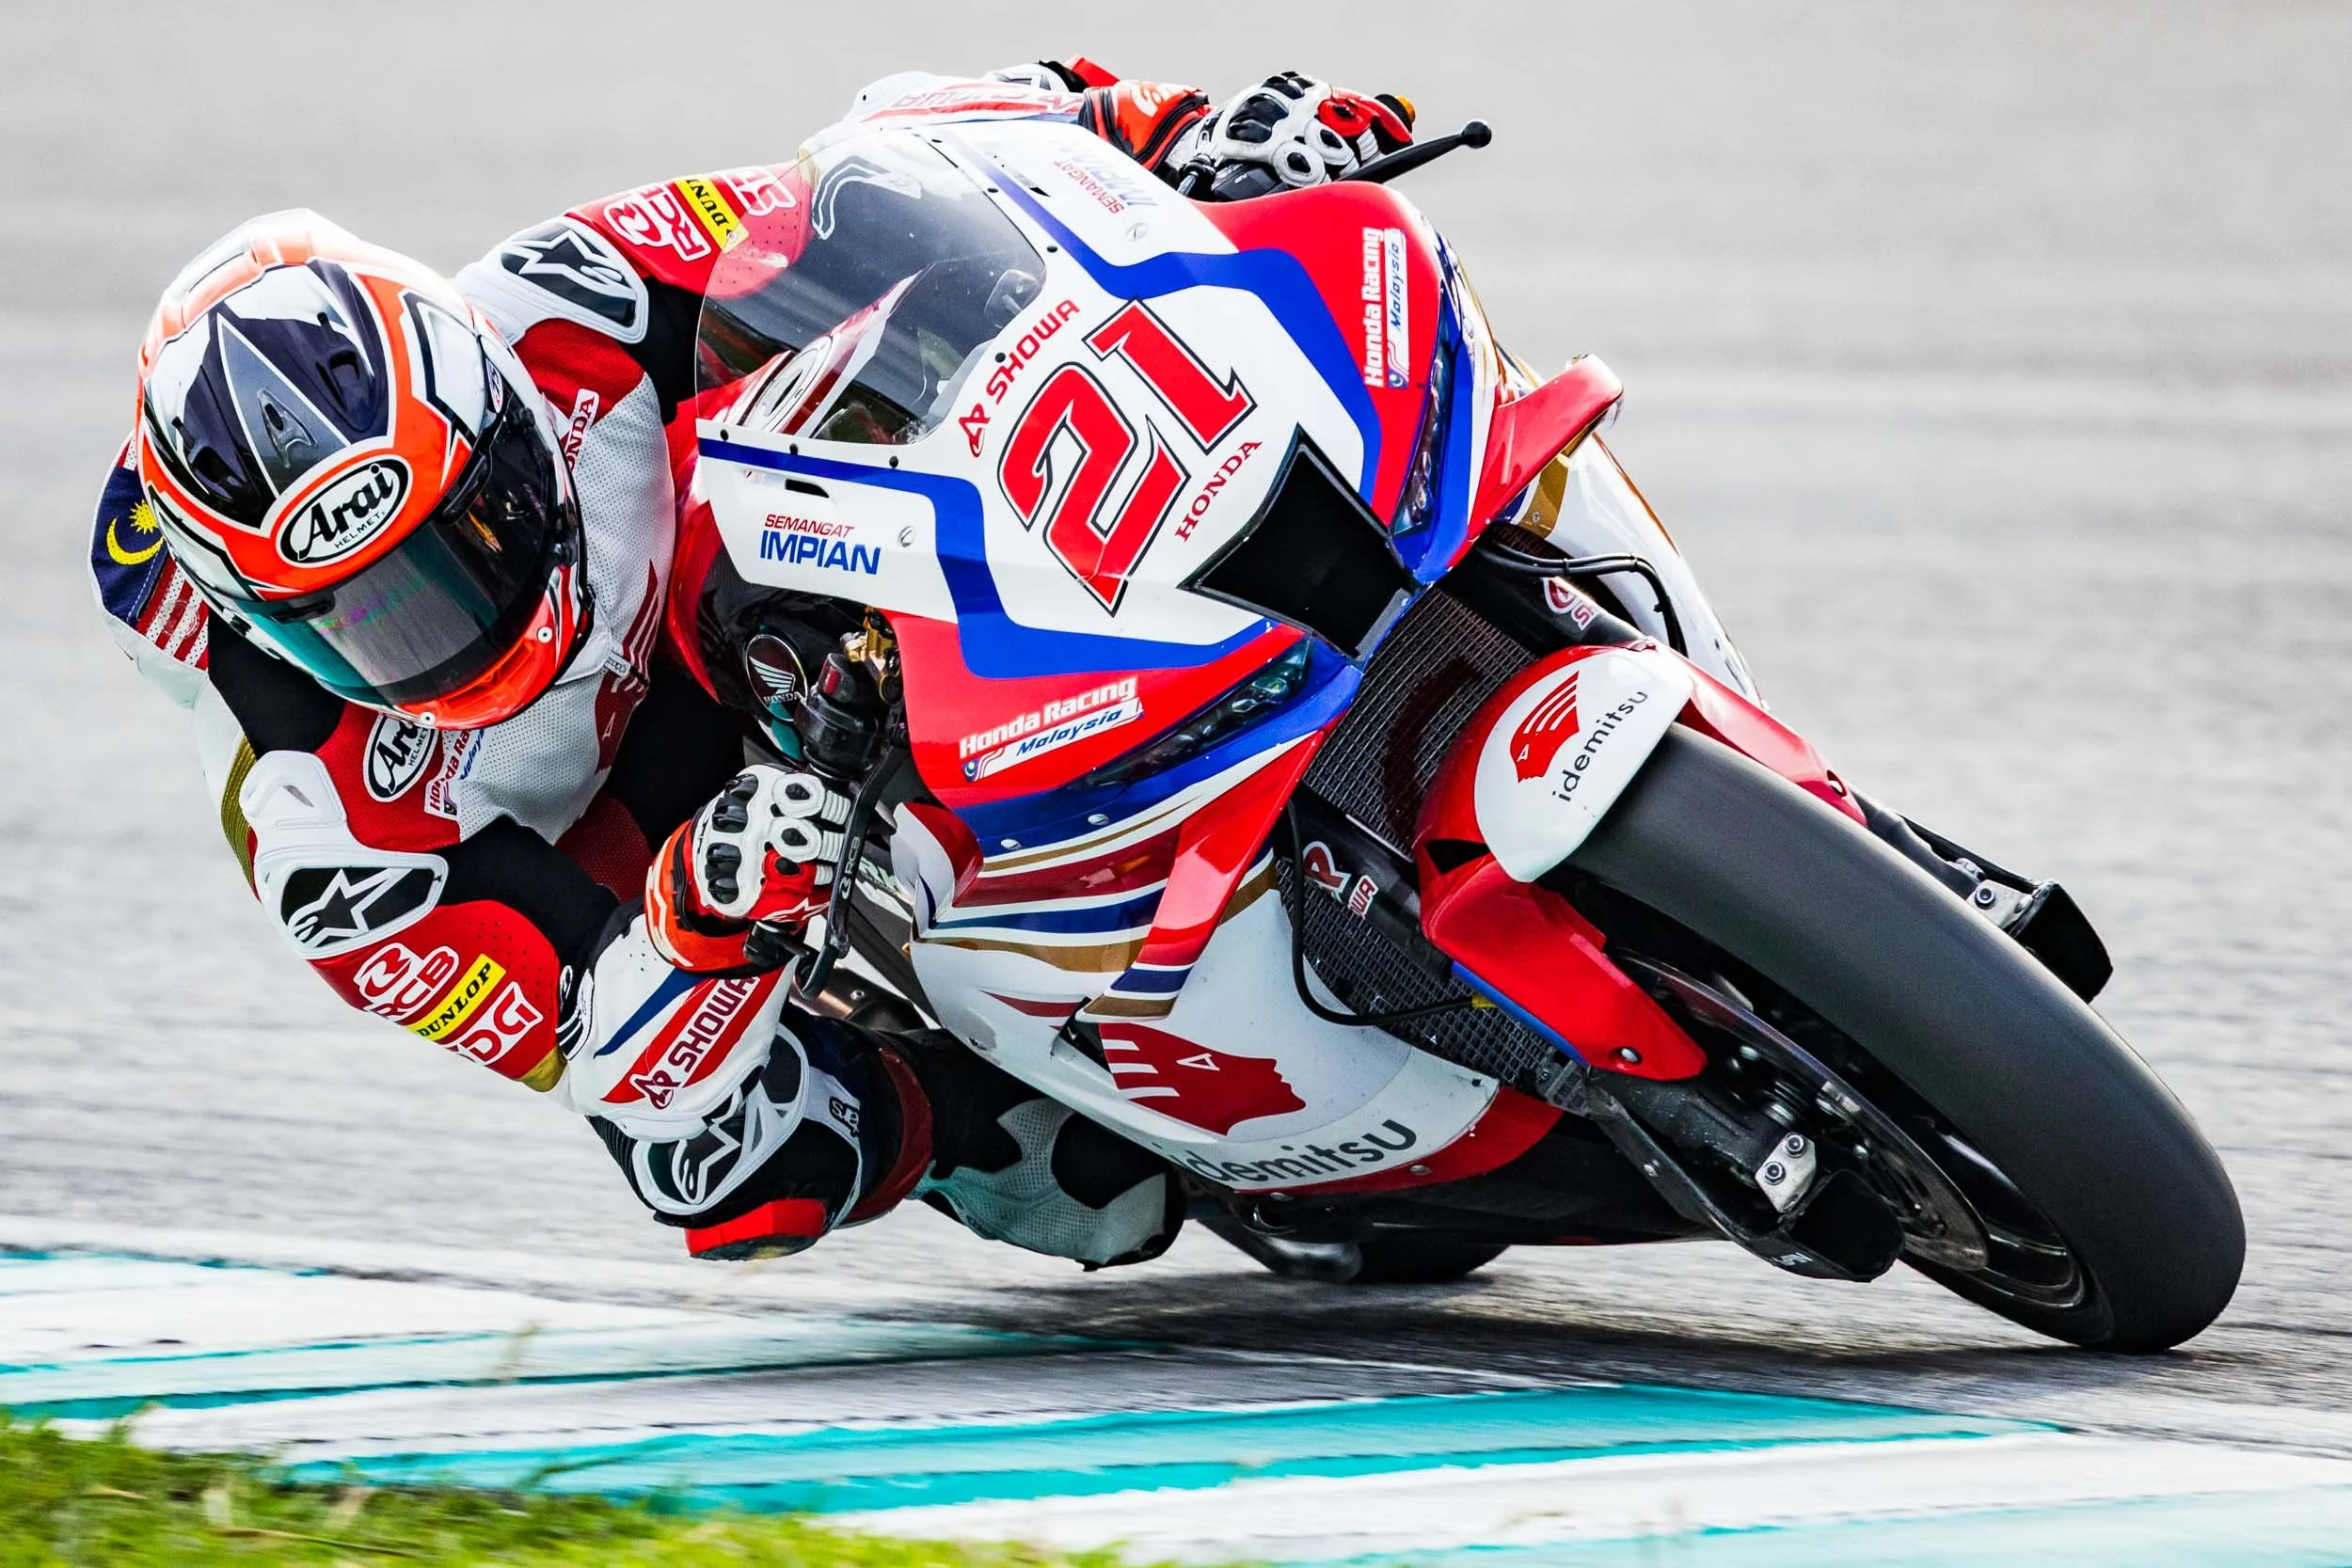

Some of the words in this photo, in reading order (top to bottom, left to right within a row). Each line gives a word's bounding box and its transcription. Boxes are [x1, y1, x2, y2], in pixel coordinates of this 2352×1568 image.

[1361, 226, 1385, 302] Racing
[1389, 243, 1405, 332] Malaysia
[986, 300, 1080, 405] SHOWA
[1362, 303, 1385, 388] Honda
[997, 297, 1258, 618] 21
[1174, 441, 1263, 542] HONDA
[297, 464, 394, 561] Arai
[334, 511, 381, 548] HELMET
[760, 530, 882, 575] IMPIAN
[765, 514, 854, 538] SEMANGAT
[959, 711, 1041, 759] Honda
[1042, 675, 1138, 725] Racing
[1016, 708, 1123, 756] Malaysia
[1552, 691, 1648, 801] idemitsu
[845, 836, 860, 874] RCB
[416, 962, 491, 1037] DUNLOP
[668, 977, 755, 1073] SHOWA
[1152, 1119, 1417, 1182] idemitsu
